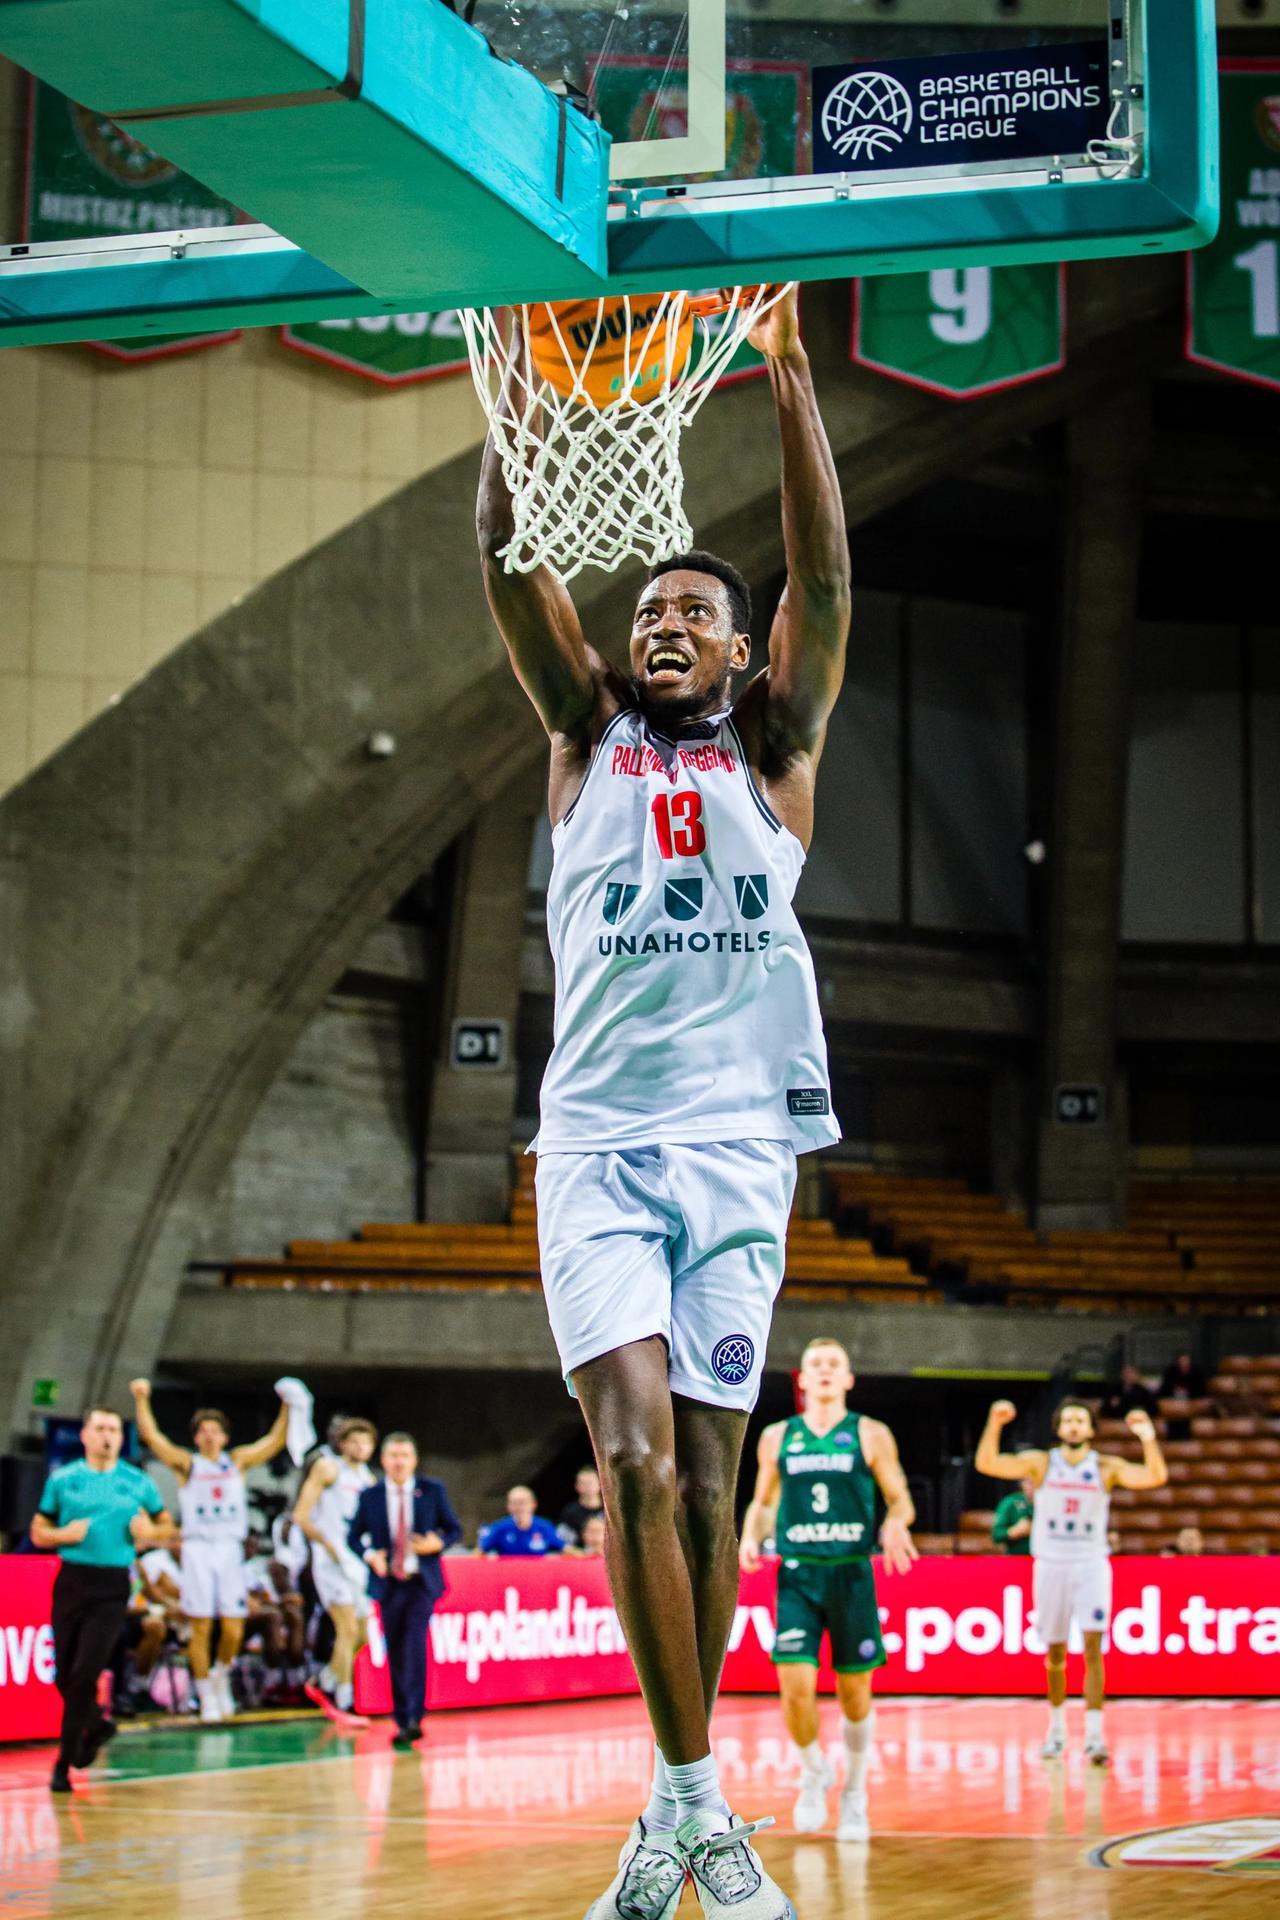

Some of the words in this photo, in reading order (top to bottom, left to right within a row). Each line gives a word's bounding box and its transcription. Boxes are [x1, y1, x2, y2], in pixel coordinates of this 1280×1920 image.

[919, 66, 1080, 97] BASKETBALL
[919, 86, 1101, 121] CHAMPIONS
[920, 117, 1017, 143] LEAGUE
[930, 266, 991, 343] 9
[651, 790, 706, 859] 13
[599, 930, 770, 956] UNAHOTELS
[460, 1032, 498, 1058] D1
[811, 1482, 830, 1514] 3
[0, 1623, 57, 1687] ve
